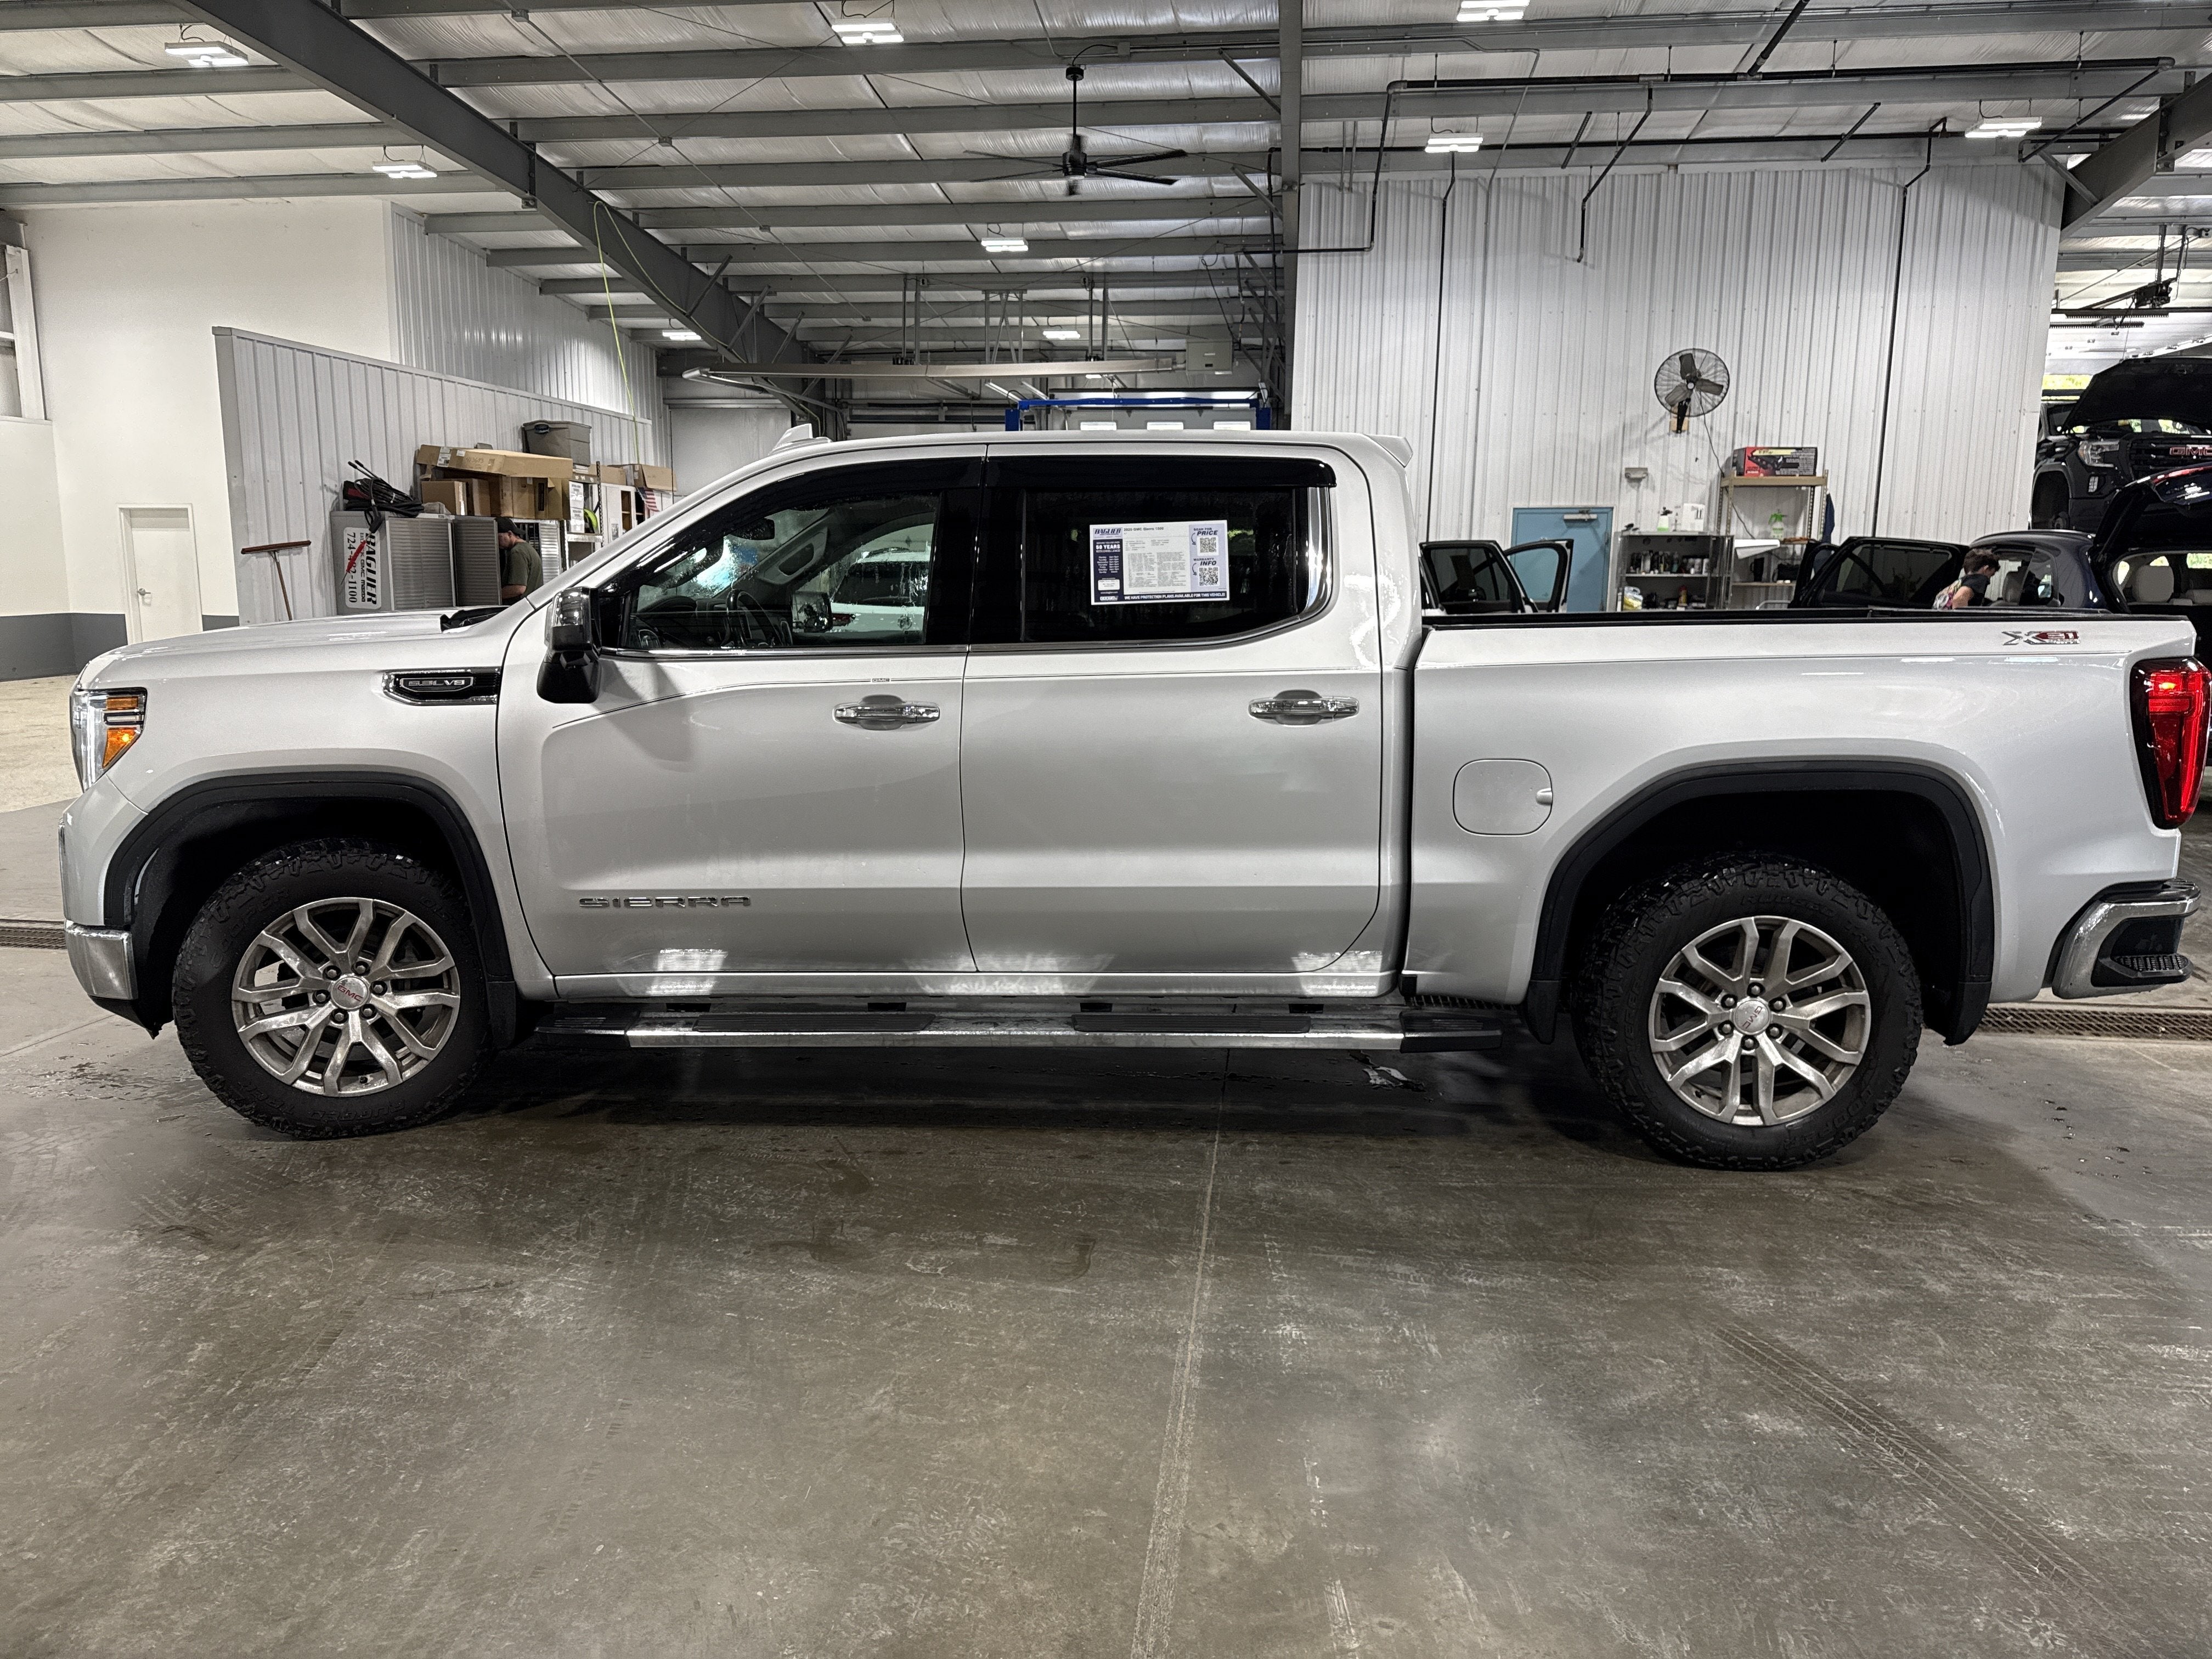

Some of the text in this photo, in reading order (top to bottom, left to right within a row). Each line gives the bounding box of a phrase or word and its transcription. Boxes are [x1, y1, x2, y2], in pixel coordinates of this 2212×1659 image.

[347, 532, 358, 603] 724-2-1100
[365, 532, 377, 605] BAGLIER
[579, 896, 751, 908] SIERRA
[337, 985, 364, 1002] GMC
[1742, 1006, 1763, 1029] GMC
